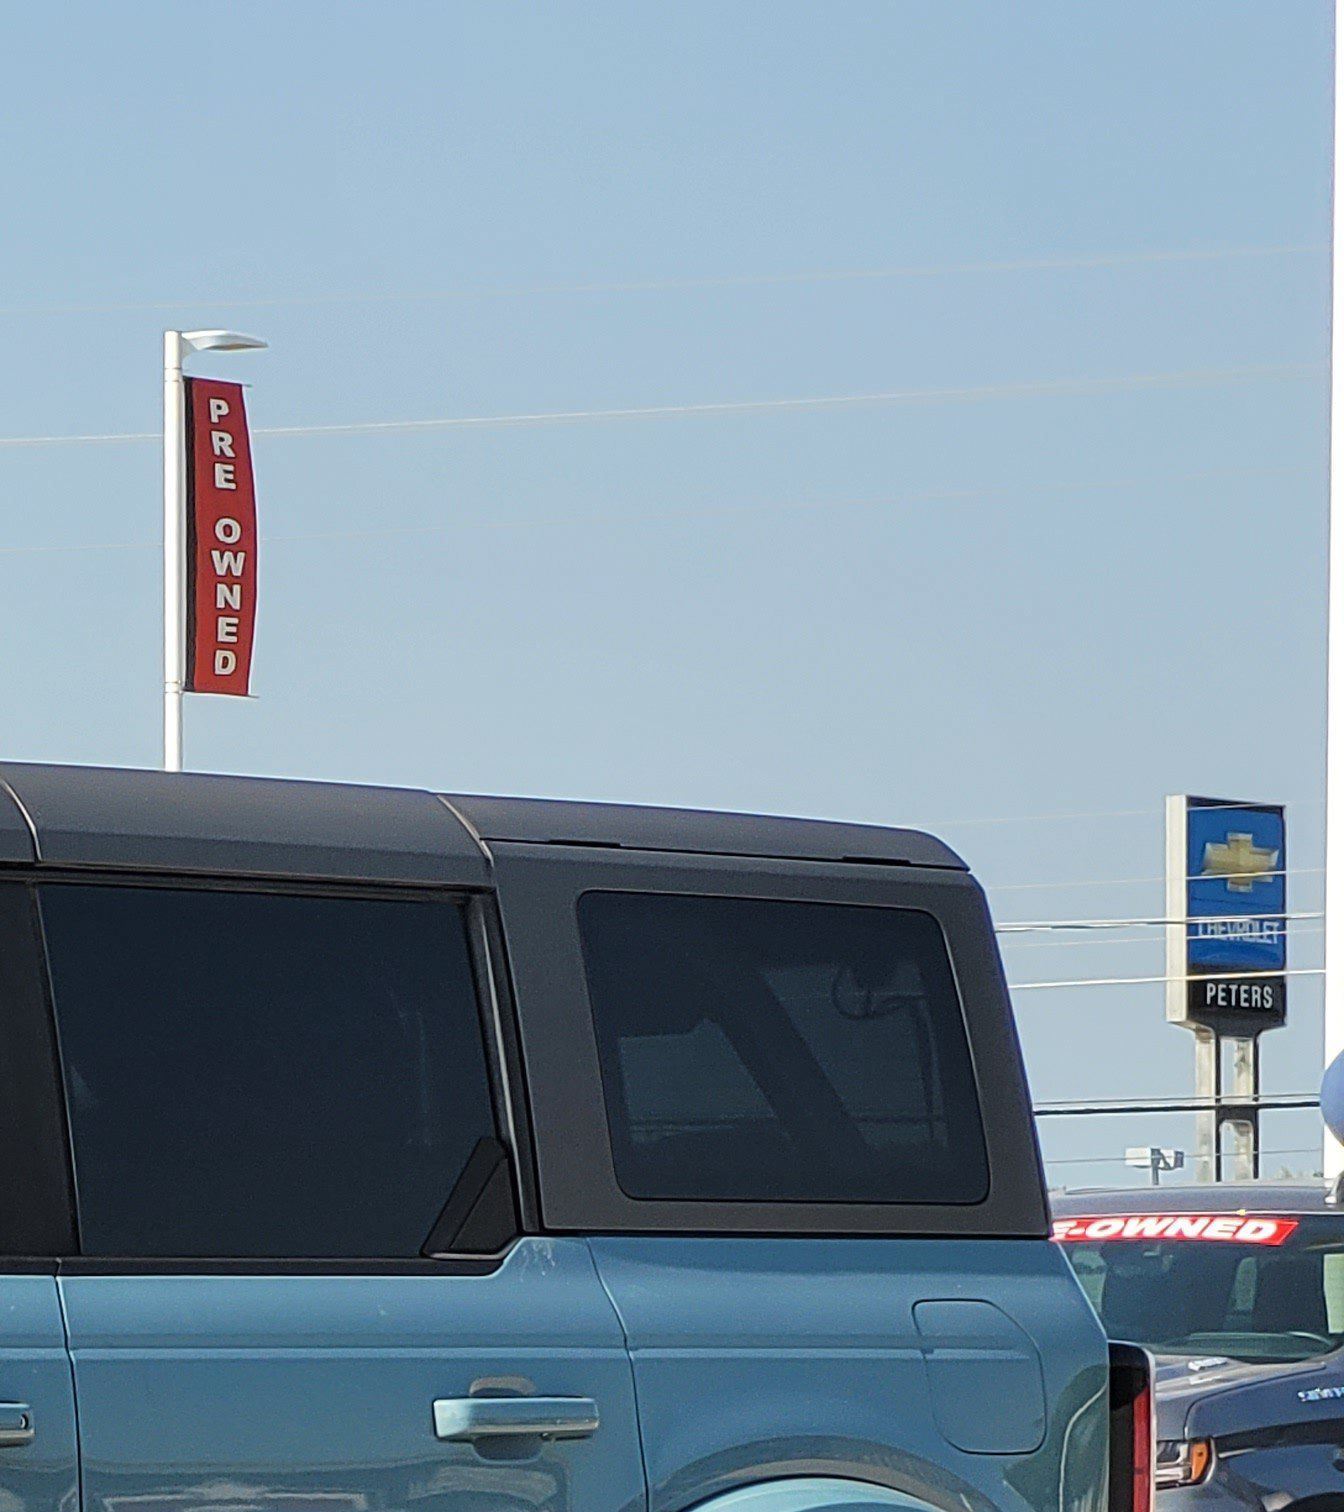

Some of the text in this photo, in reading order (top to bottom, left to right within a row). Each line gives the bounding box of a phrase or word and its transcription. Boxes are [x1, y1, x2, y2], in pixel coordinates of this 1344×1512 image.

[209, 399, 246, 676] PRE OWNED
[1205, 982, 1274, 1009] PETERS
